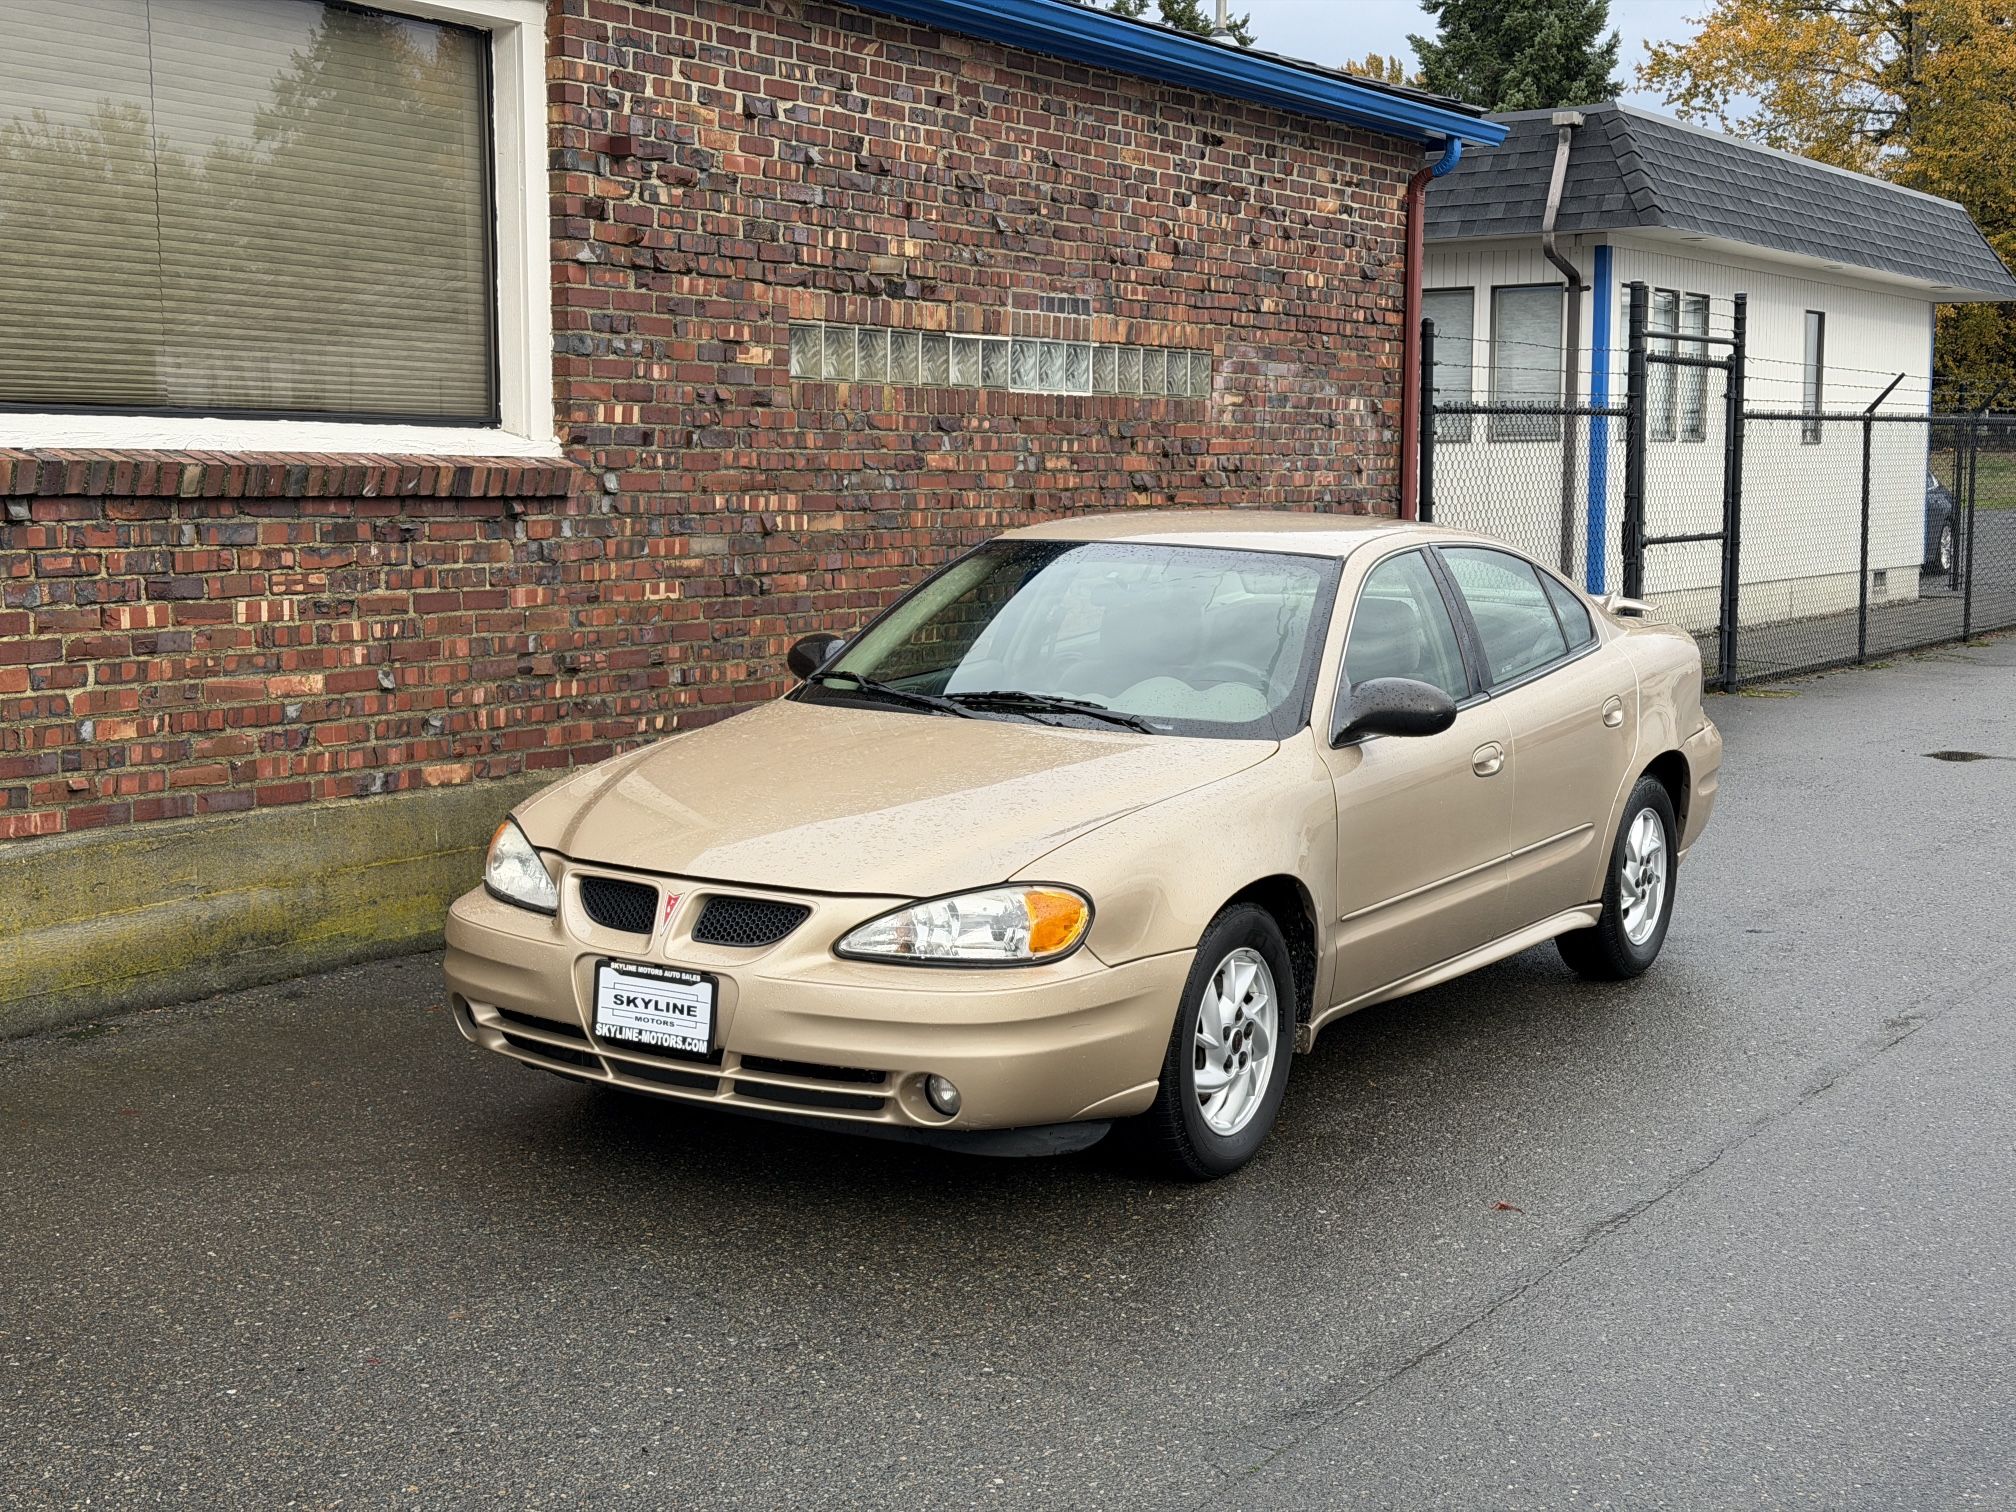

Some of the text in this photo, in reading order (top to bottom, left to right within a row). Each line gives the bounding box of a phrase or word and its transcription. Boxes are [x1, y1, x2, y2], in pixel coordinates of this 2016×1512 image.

[610, 962, 701, 982] SKYLINE MOTORS AUTO SALES
[613, 994, 698, 1017] SKYLINE
[635, 1016, 675, 1027] MOTORS
[595, 1023, 707, 1053] SKYLINE-MOTORS.COM
